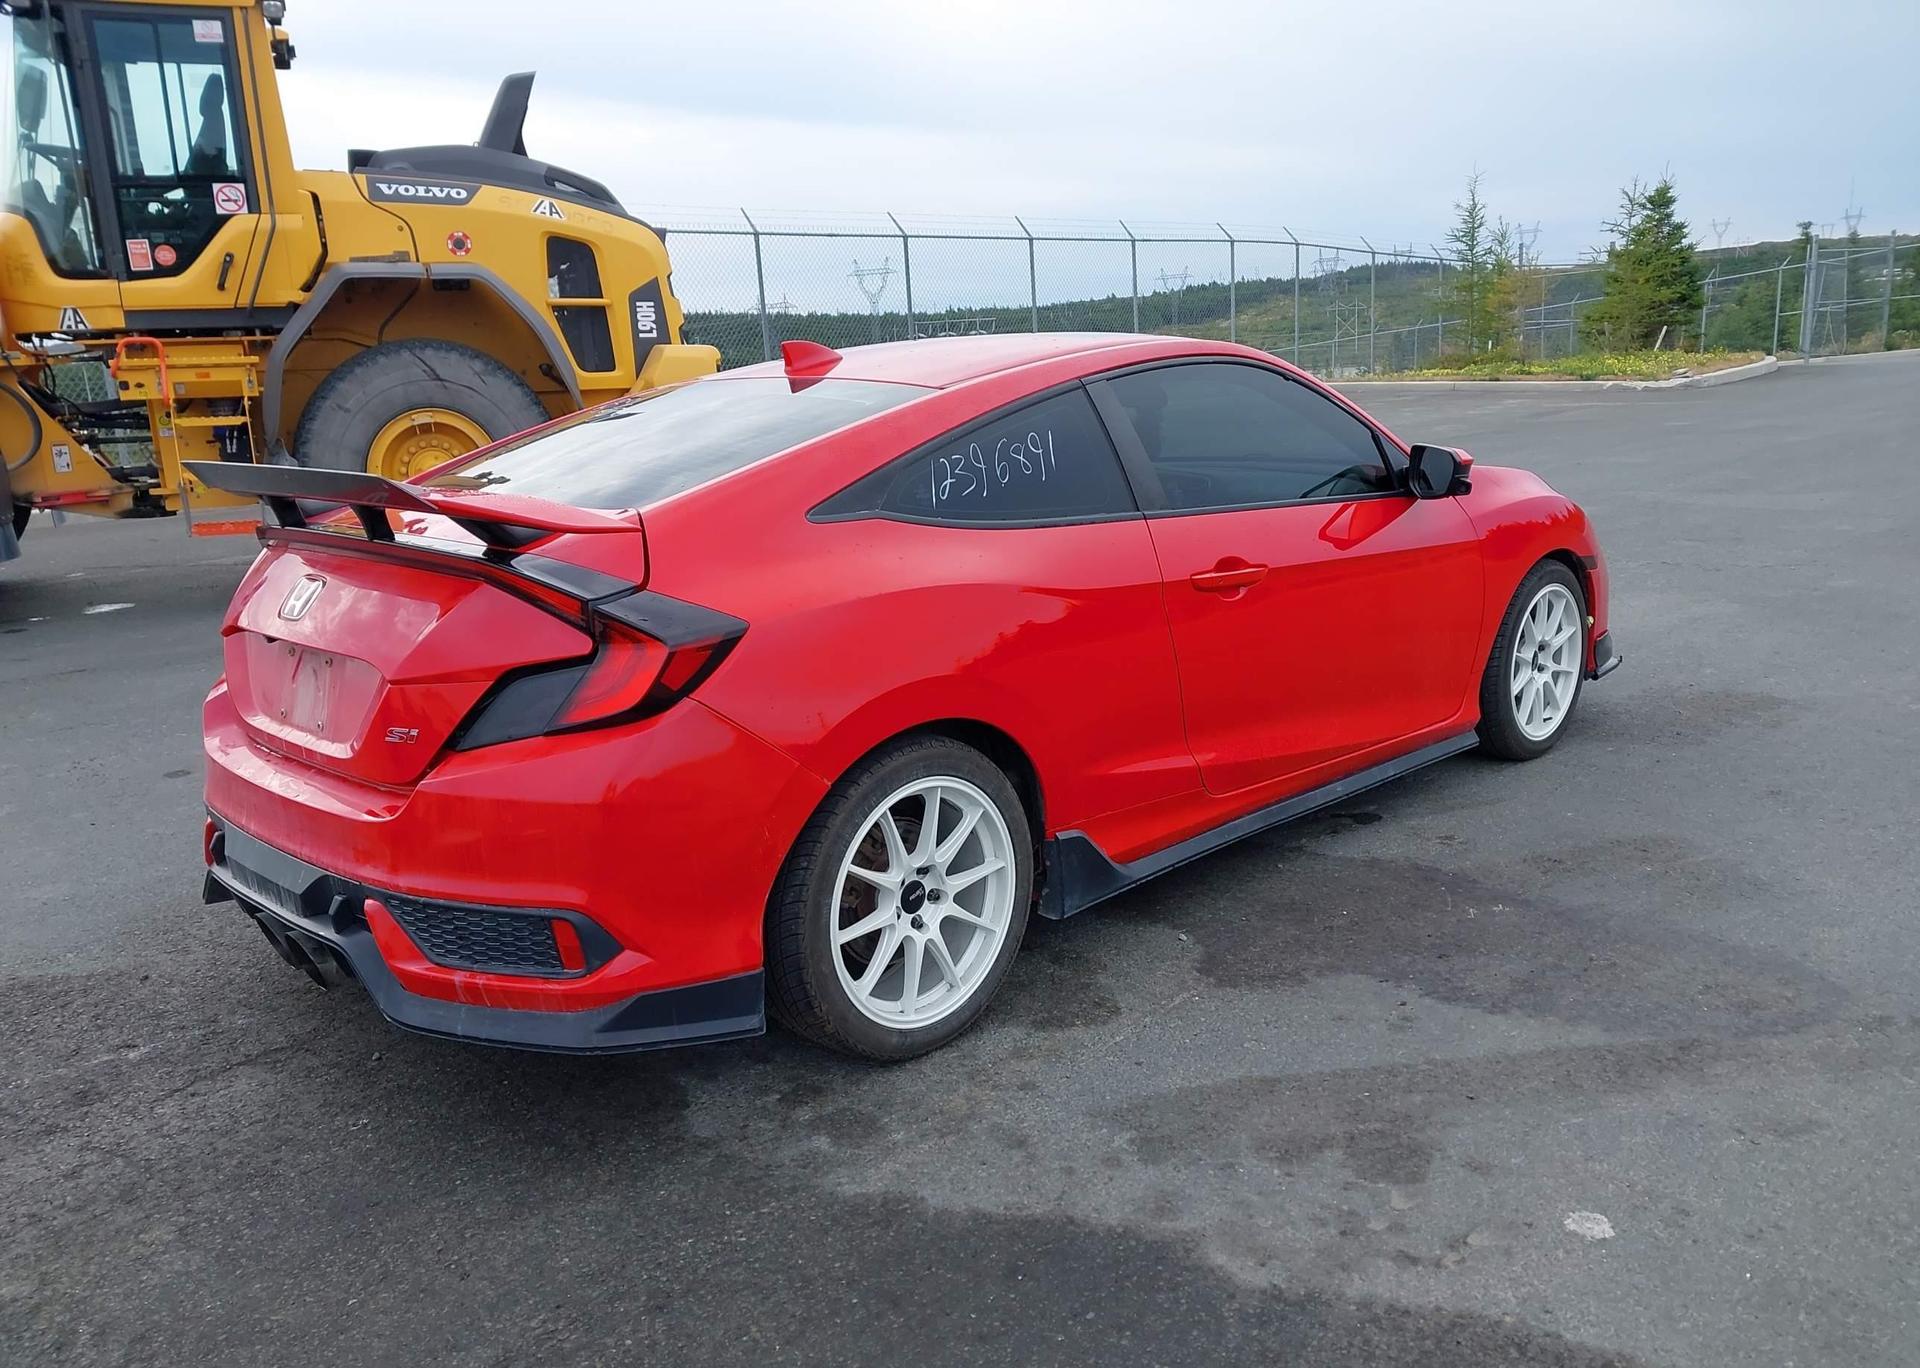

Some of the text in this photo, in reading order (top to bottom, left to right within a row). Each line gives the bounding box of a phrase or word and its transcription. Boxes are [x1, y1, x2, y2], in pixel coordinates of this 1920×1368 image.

[375, 183, 468, 199] VOLVO
[635, 301, 657, 338] L90H
[384, 727, 419, 743] Si
